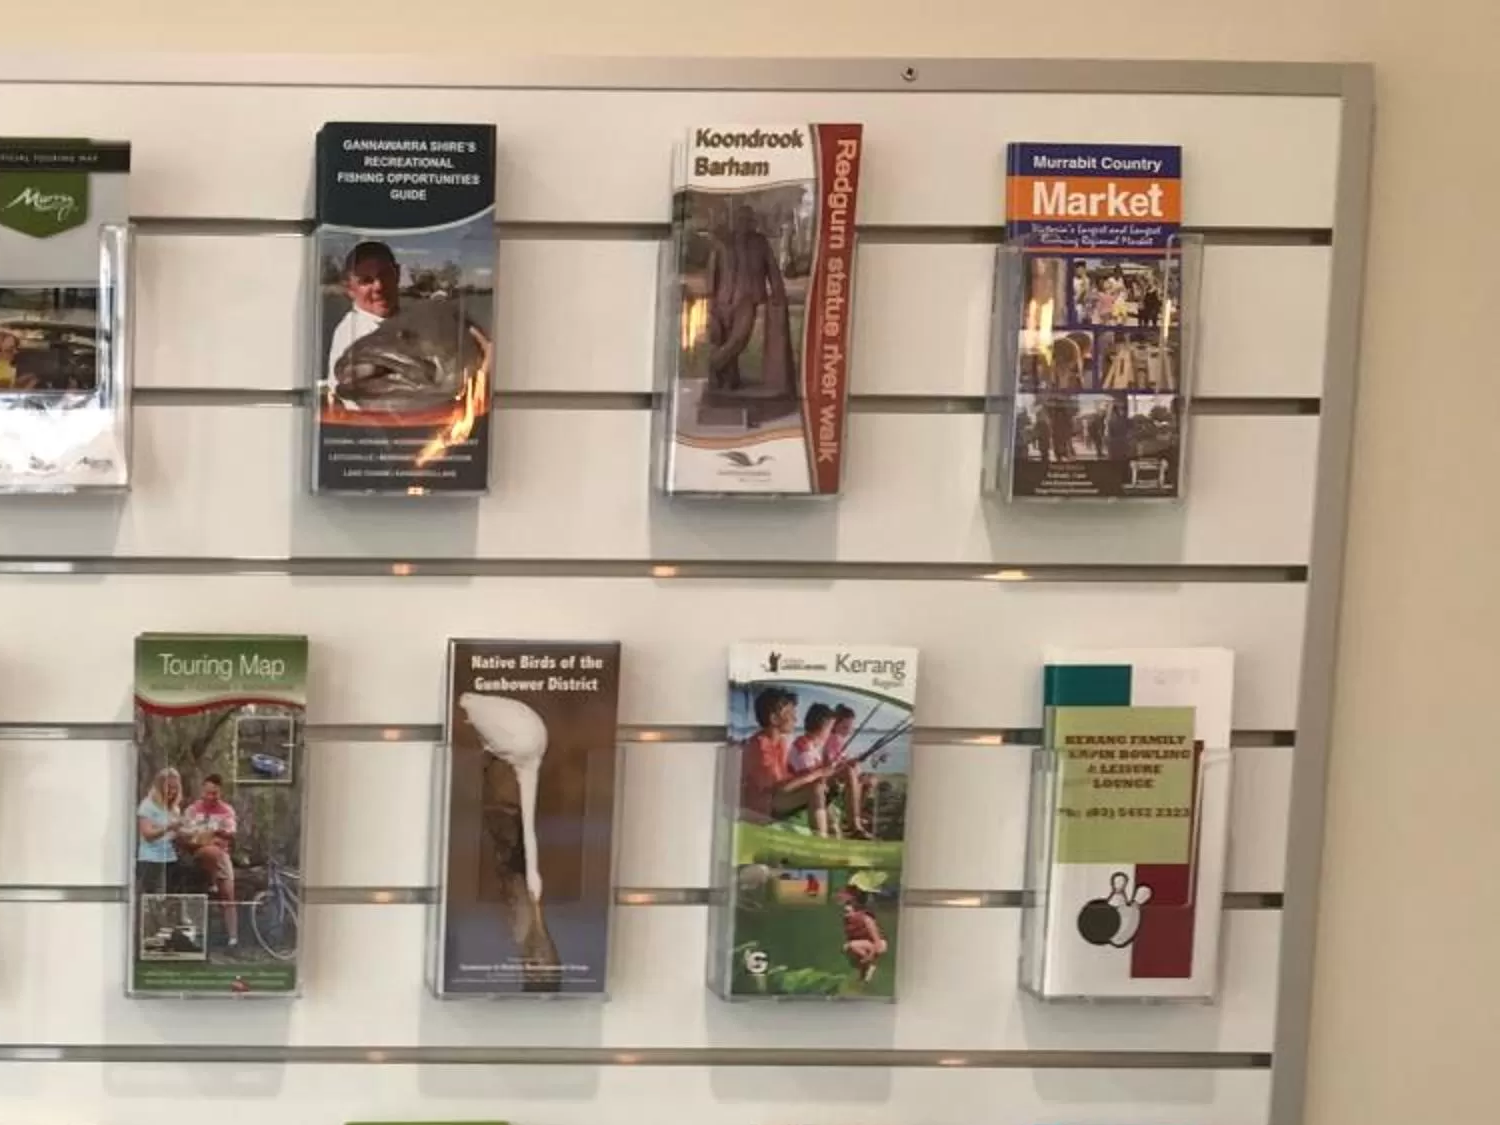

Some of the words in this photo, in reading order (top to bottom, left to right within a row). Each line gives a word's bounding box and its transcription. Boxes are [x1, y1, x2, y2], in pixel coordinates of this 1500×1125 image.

[343, 139, 427, 151] GANNAWARRA
[430, 141, 477, 153] SHIRE'S
[696, 128, 803, 149] Koondrook
[364, 156, 453, 168] RECREATIONAL
[694, 156, 769, 176] Barham
[1033, 155, 1097, 170] Murrabit
[1101, 157, 1162, 173] Country
[338, 171, 384, 184] FISHING
[387, 173, 480, 185] OPPORTUNITIES
[390, 188, 426, 200] GUIDE
[827, 139, 858, 249] Redgum
[1032, 181, 1164, 217] Market
[824, 257, 845, 337] statue
[821, 344, 843, 399] river
[819, 404, 838, 463] walk
[158, 653, 233, 681] Touring
[239, 654, 285, 680] Map
[471, 656, 516, 670] Native
[520, 656, 556, 670] Birds
[560, 656, 576, 669] of
[579, 656, 603, 670] the
[835, 653, 906, 680] Kerang
[474, 677, 544, 691] Gunbower
[548, 677, 599, 692] District
[1065, 735, 1125, 745] KERANG
[1130, 735, 1186, 745] FAMILY
[1120, 750, 1191, 760] BOWLING
